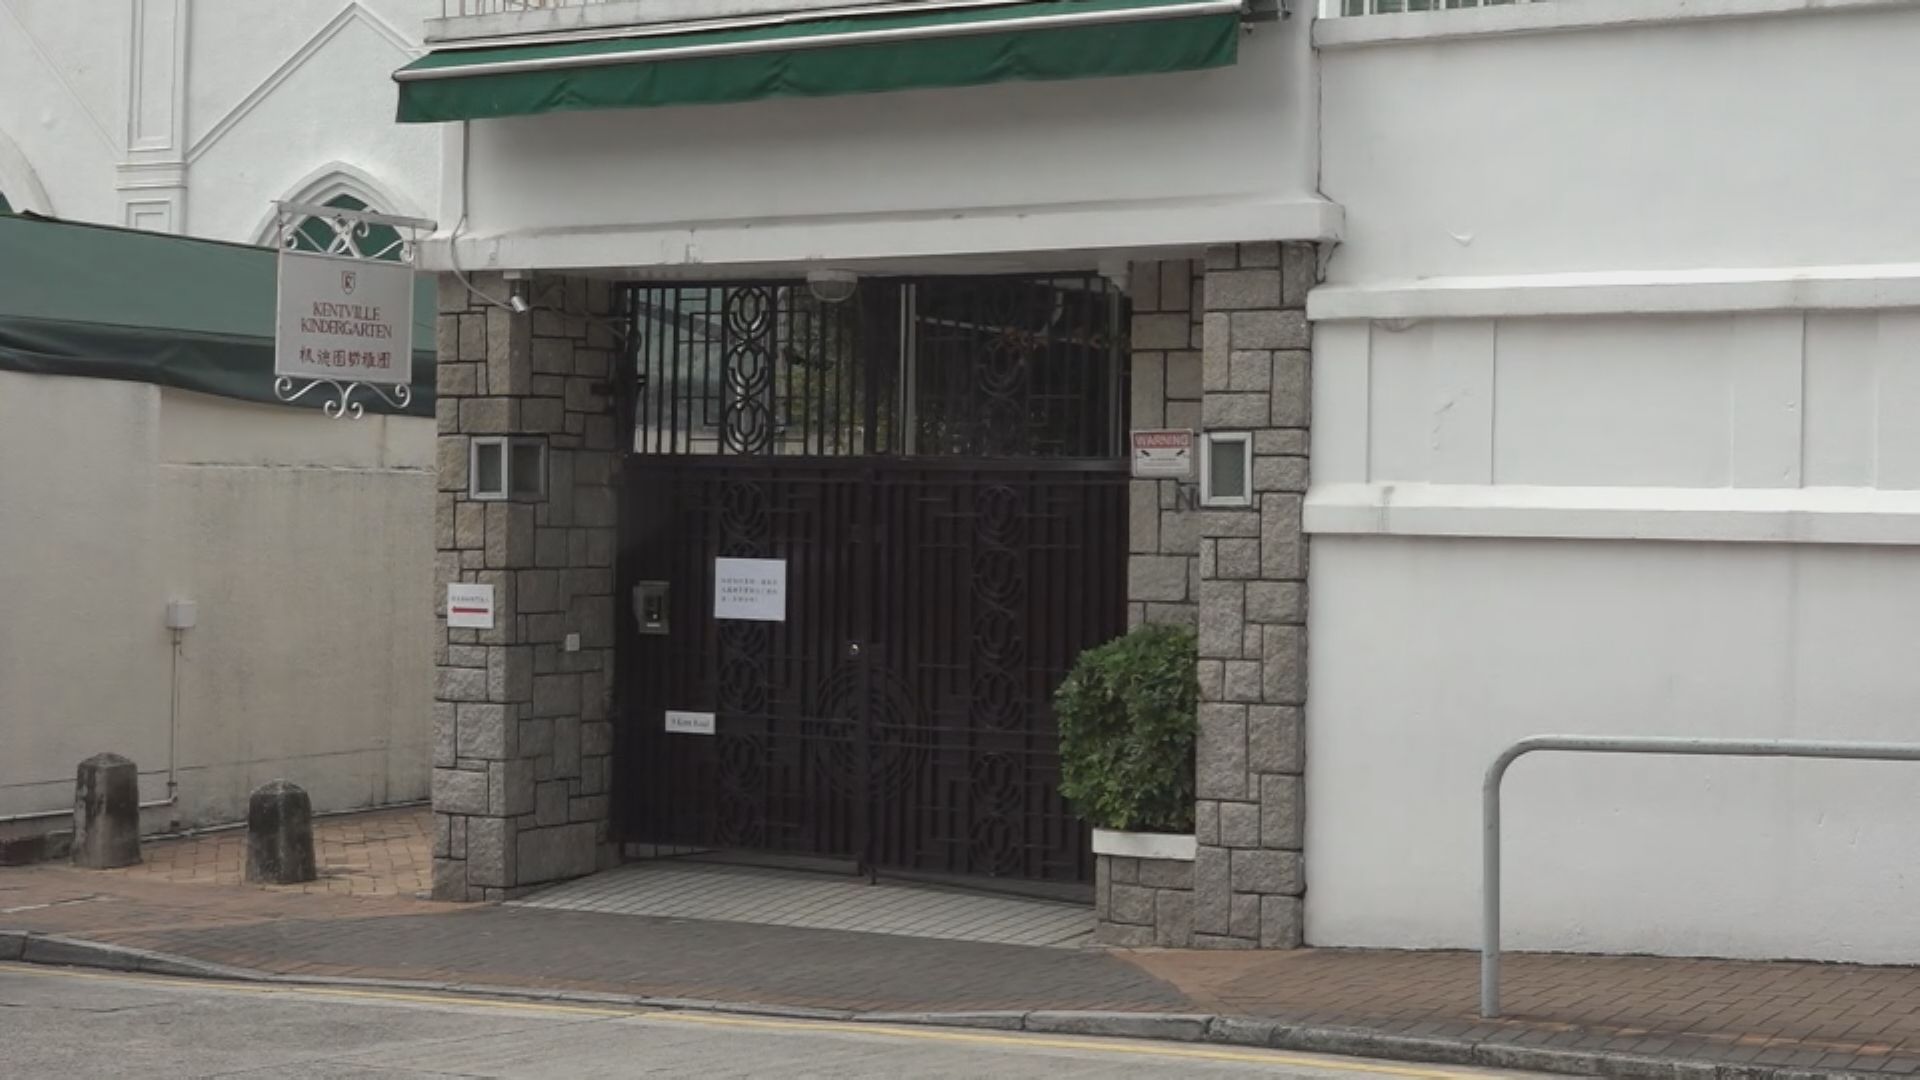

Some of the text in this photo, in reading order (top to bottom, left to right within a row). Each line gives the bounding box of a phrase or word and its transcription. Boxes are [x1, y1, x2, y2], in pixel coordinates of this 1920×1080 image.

[313, 301, 381, 321] KENTVILLE
[301, 318, 393, 339] KINDERGARTEN
[1134, 432, 1190, 447] WARNING
